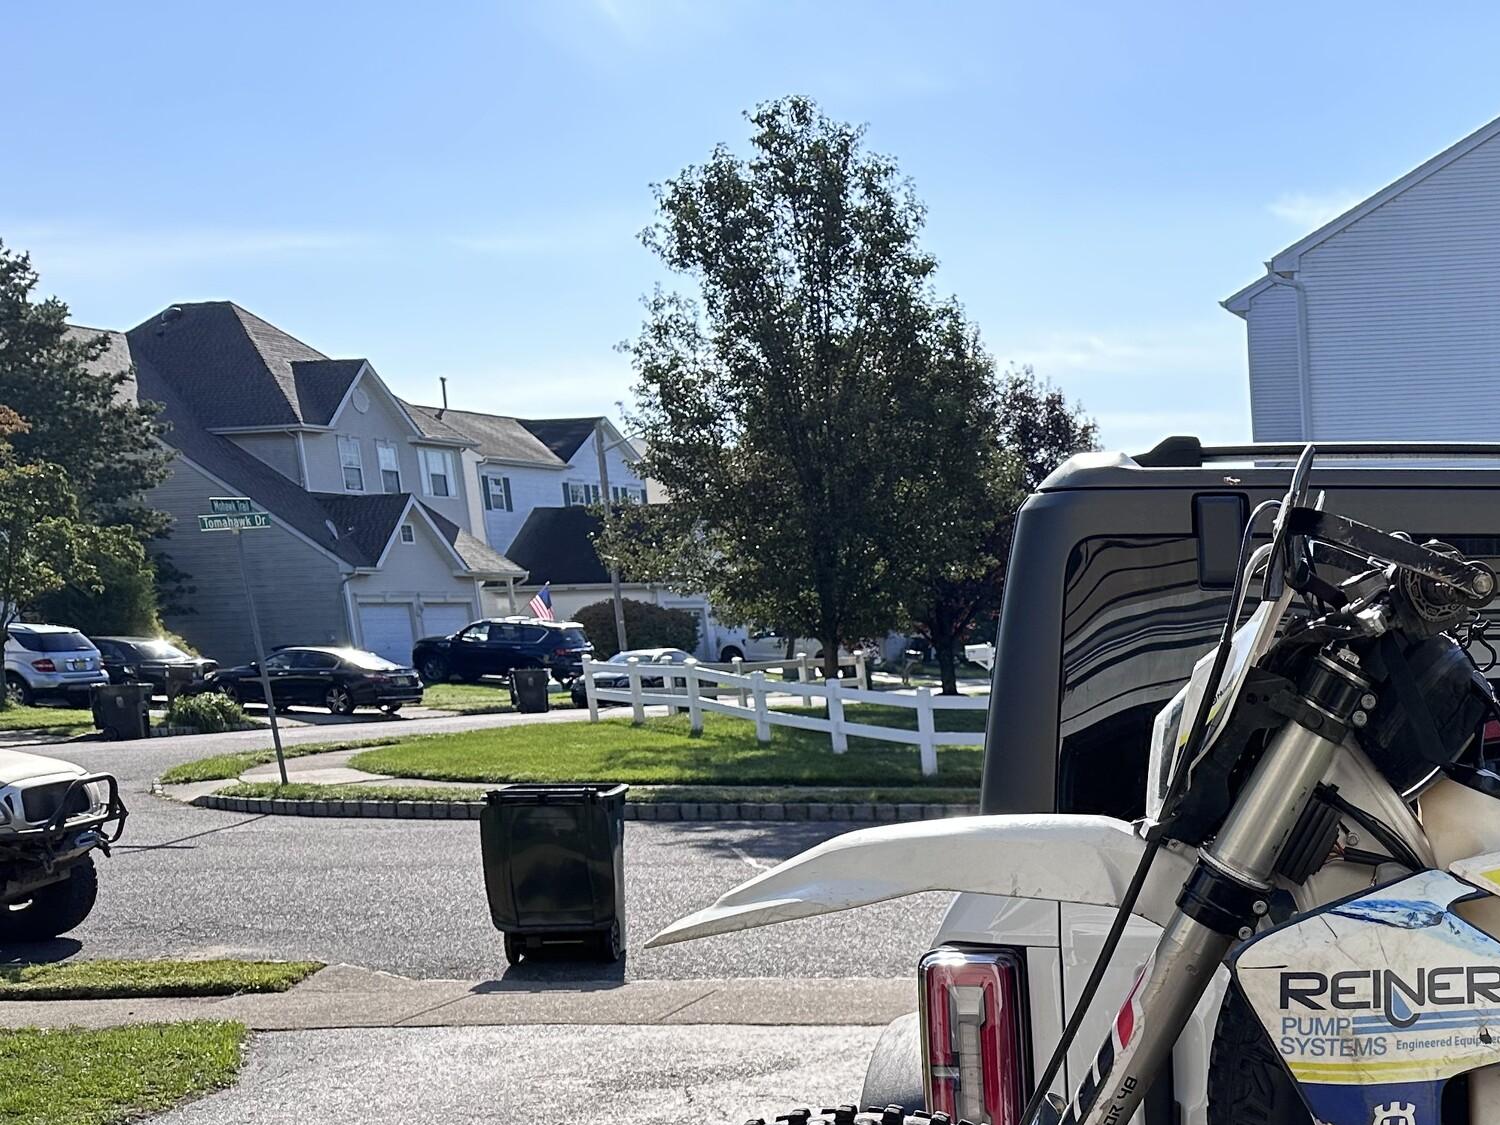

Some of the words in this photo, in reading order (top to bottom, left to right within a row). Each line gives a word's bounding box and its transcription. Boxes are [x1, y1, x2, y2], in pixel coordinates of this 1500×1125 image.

[213, 500, 237, 512] Mohawk
[203, 515, 252, 529] Tomahawk
[255, 515, 266, 526] Dr
[1281, 1016, 1351, 1036] PUMP
[1280, 1037, 1388, 1057] SYSTEMS
[1396, 1036, 1452, 1052] Engineered
[1117, 1075, 1139, 1102] 48
